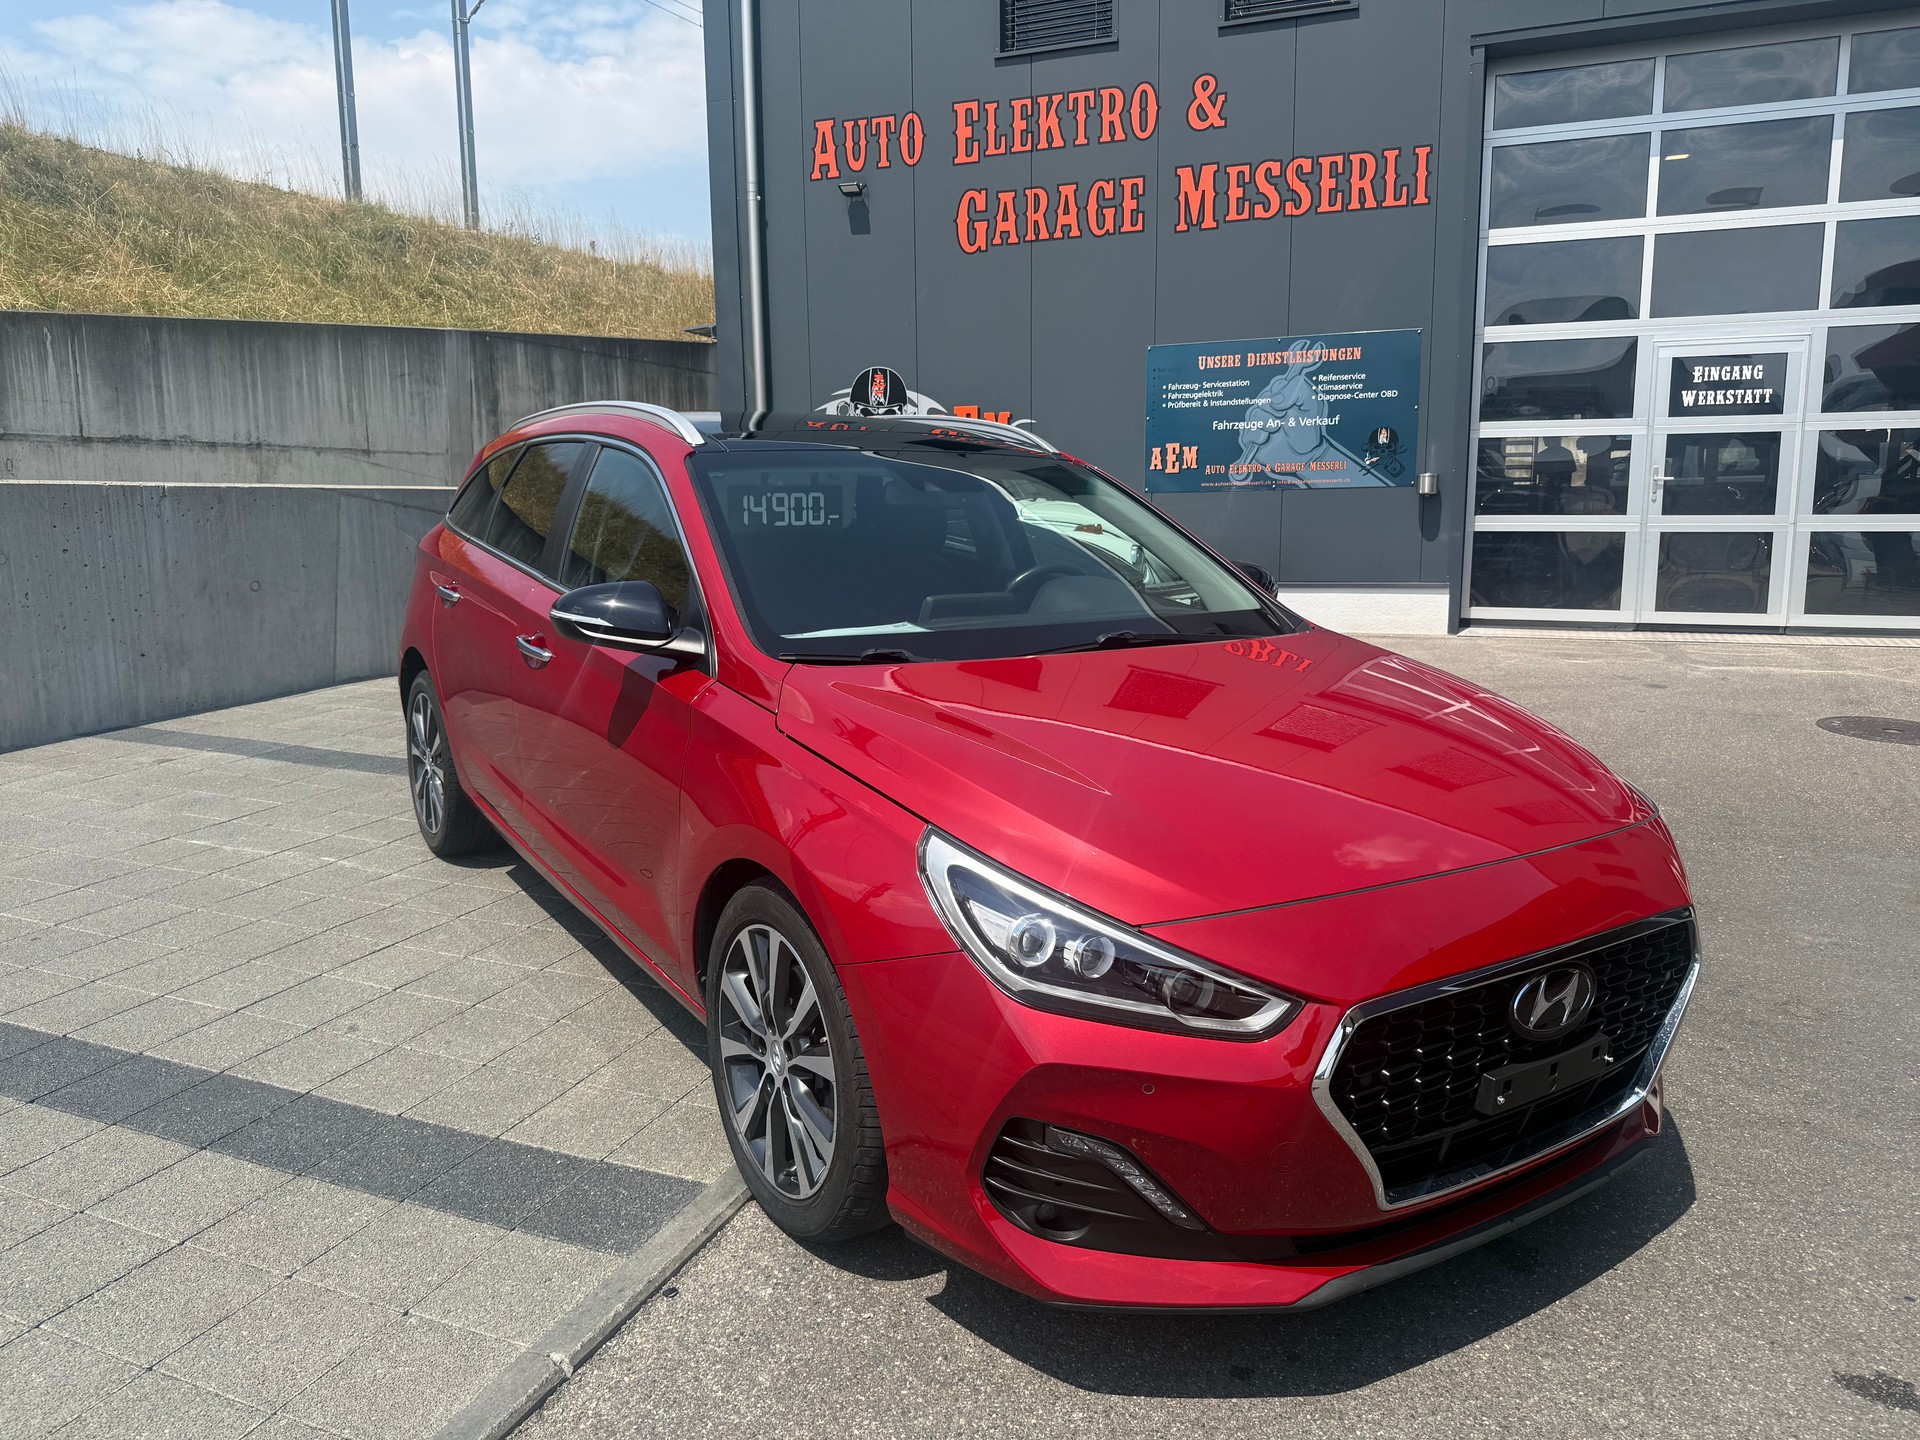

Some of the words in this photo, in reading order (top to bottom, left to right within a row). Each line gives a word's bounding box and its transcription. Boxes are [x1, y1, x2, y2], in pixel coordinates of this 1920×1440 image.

[809, 110, 925, 182] AUTO
[952, 80, 1161, 166] ELEKTRO
[1186, 72, 1227, 132] &
[954, 174, 1147, 255] GARAGE
[1174, 143, 1433, 234] MESSERLI
[1198, 355, 1241, 371] UNSERE
[1247, 347, 1362, 368] DIENSTLEISTUNGEN
[1318, 372, 1366, 382] Reifenservice
[1692, 365, 1764, 383] EINGANG
[1168, 382, 1201, 392] Fahrzeug-
[1202, 380, 1250, 389] Servicestation
[1318, 382, 1364, 391] Klimaservice
[1167, 390, 1224, 401] Fahrzeugelektrik
[1167, 400, 1201, 409] Prüfbereit
[1203, 399, 1209, 407] &
[1210, 397, 1272, 407] Instandstellungen
[1317, 391, 1379, 402] Diagnose-Center
[1380, 389, 1398, 398] OBD
[1681, 389, 1773, 407] WERKSTATT
[1212, 419, 1264, 432] Fahrzeuge
[1266, 417, 1286, 429] An-
[1288, 417, 1296, 428] &
[1299, 414, 1340, 427] Verkauf
[1149, 442, 1199, 475] AEM
[1205, 464, 1226, 475] AUTO
[1229, 463, 1262, 475] ELEKTRO
[1265, 465, 1272, 473] &
[1274, 462, 1306, 473] GARAGE
[1309, 460, 1347, 471] MESSERLI
